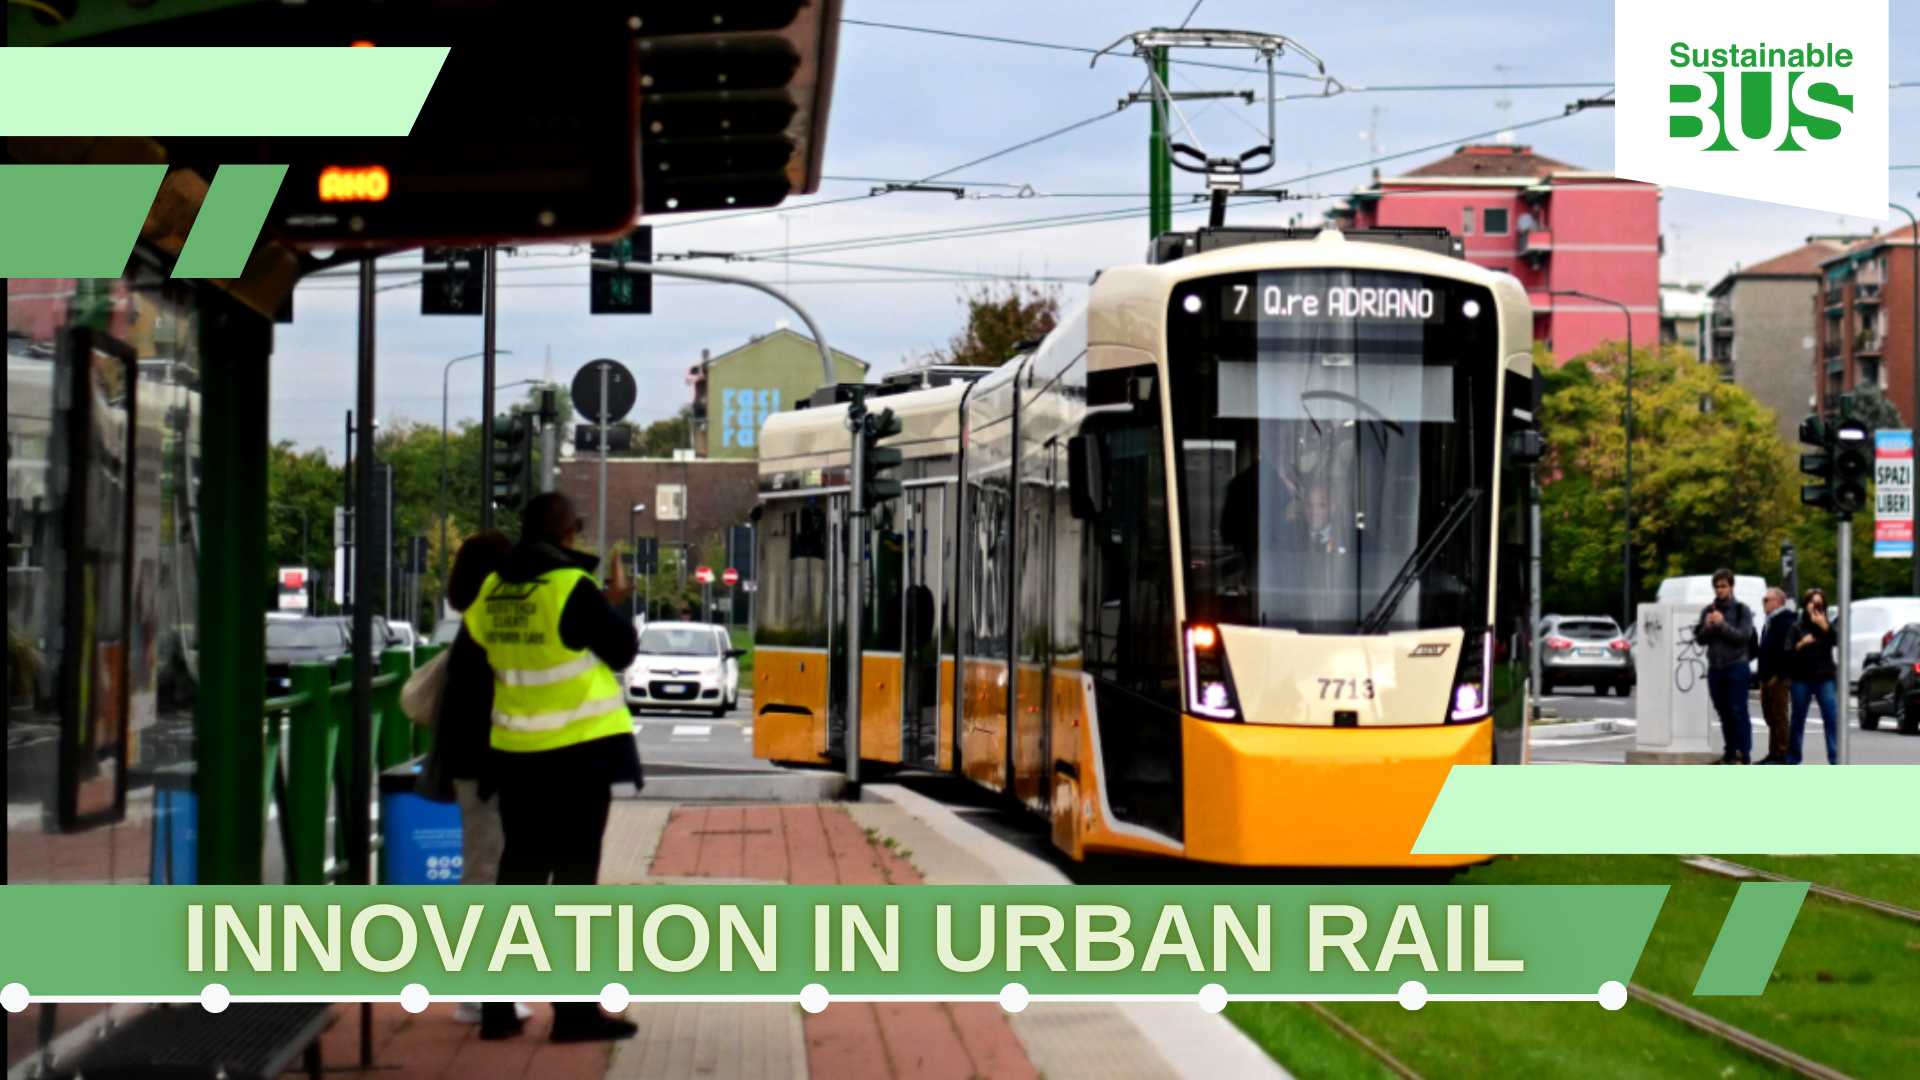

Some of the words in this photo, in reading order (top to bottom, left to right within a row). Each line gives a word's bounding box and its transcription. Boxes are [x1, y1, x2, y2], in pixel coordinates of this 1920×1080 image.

[1234, 285, 1248, 314] 7
[1264, 285, 1319, 316] Q.re
[1328, 287, 1434, 318] ADRIANO
[1877, 466, 1910, 485] SPAZI
[1877, 494, 1910, 513] LIBERI
[1318, 678, 1374, 699] 7713
